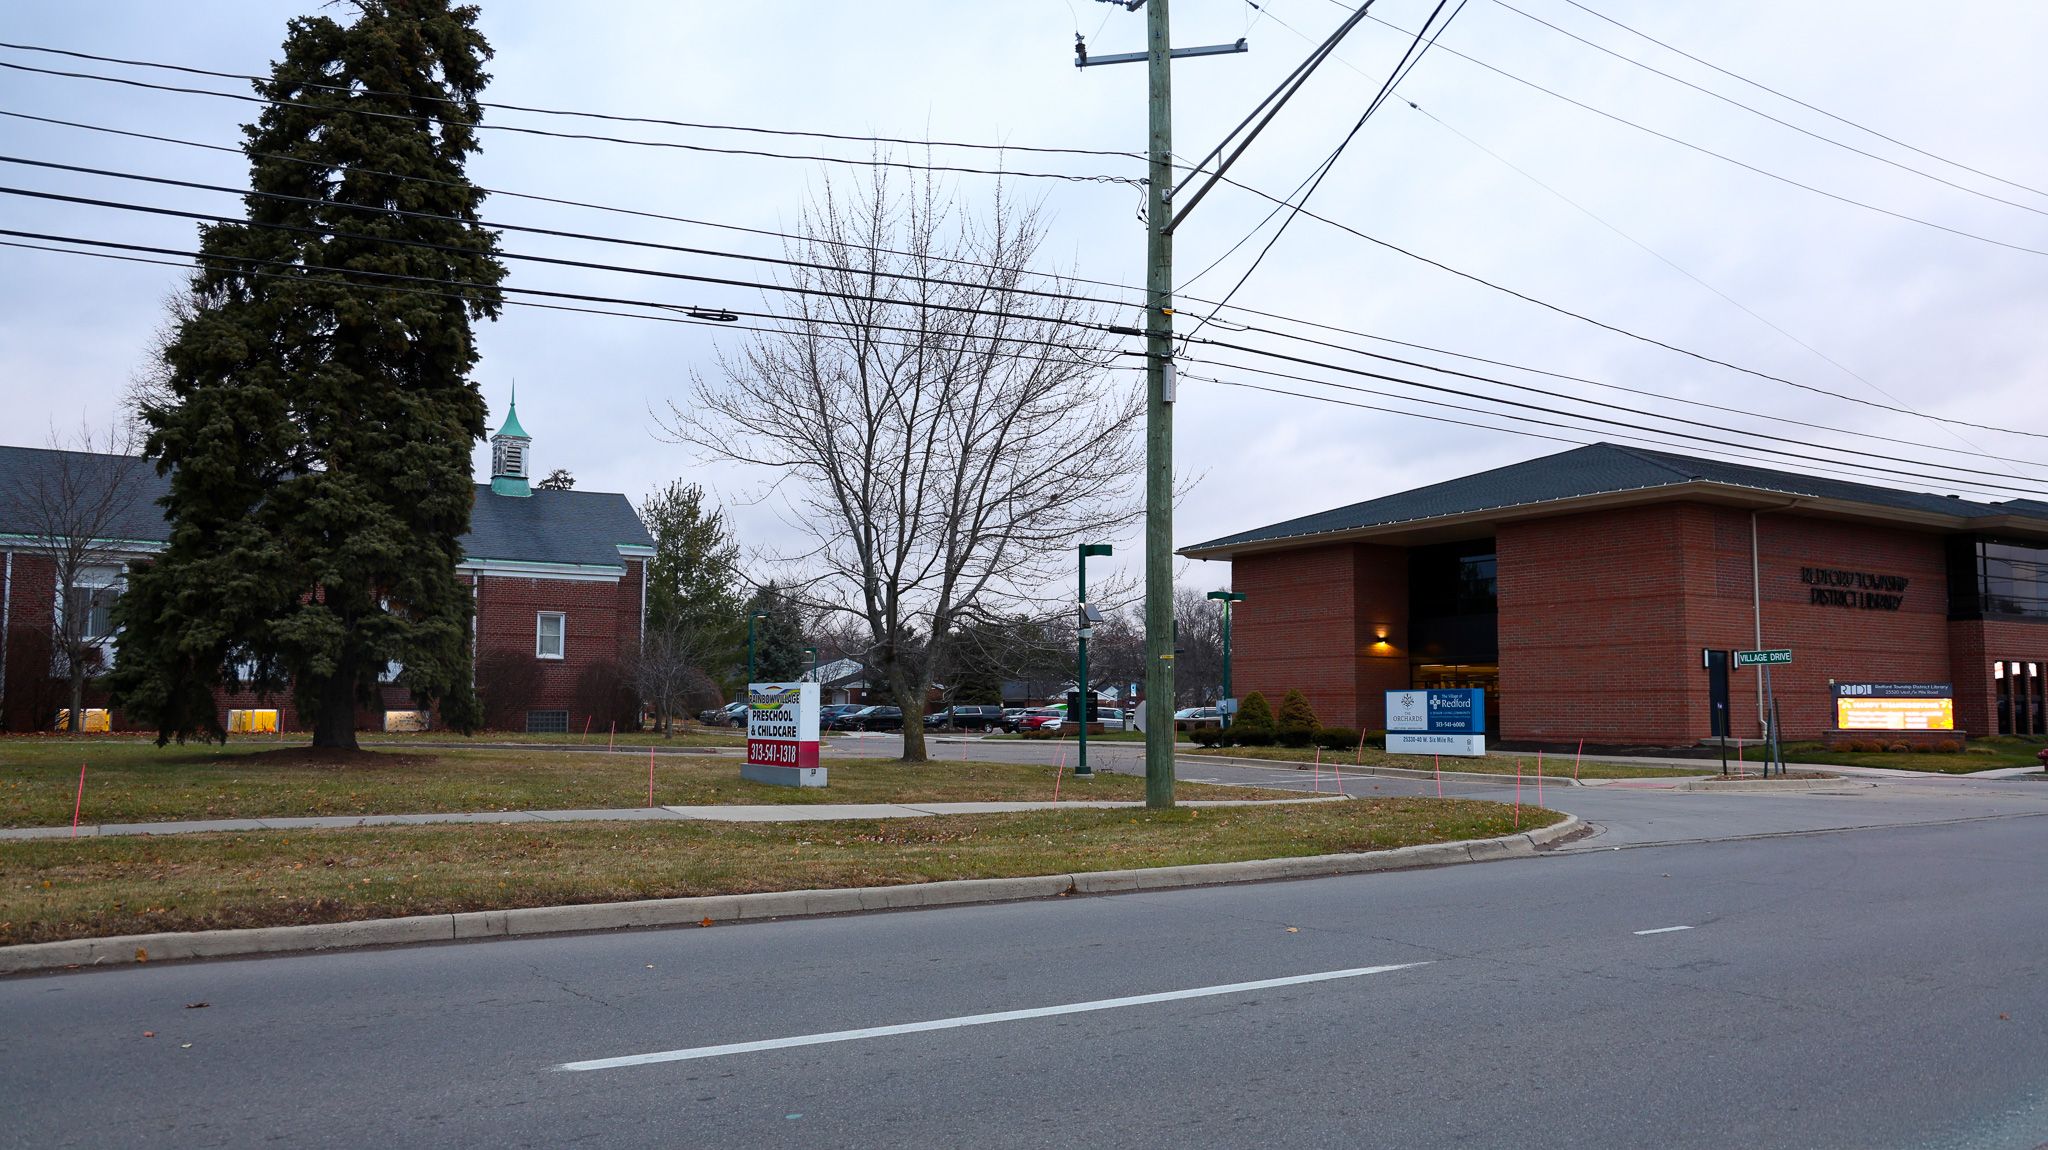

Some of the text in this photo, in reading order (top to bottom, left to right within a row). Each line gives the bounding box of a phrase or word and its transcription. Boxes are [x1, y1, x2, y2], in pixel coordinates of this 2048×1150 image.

[1740, 652, 1791, 662] VILLAGE DRIVE
[749, 693, 775, 704] RAINBOW
[1441, 698, 1471, 708] Redford
[752, 710, 793, 722] PRESCHOOL
[751, 725, 797, 738] & CHILDCARE
[750, 743, 796, 763] 313-541-1318
